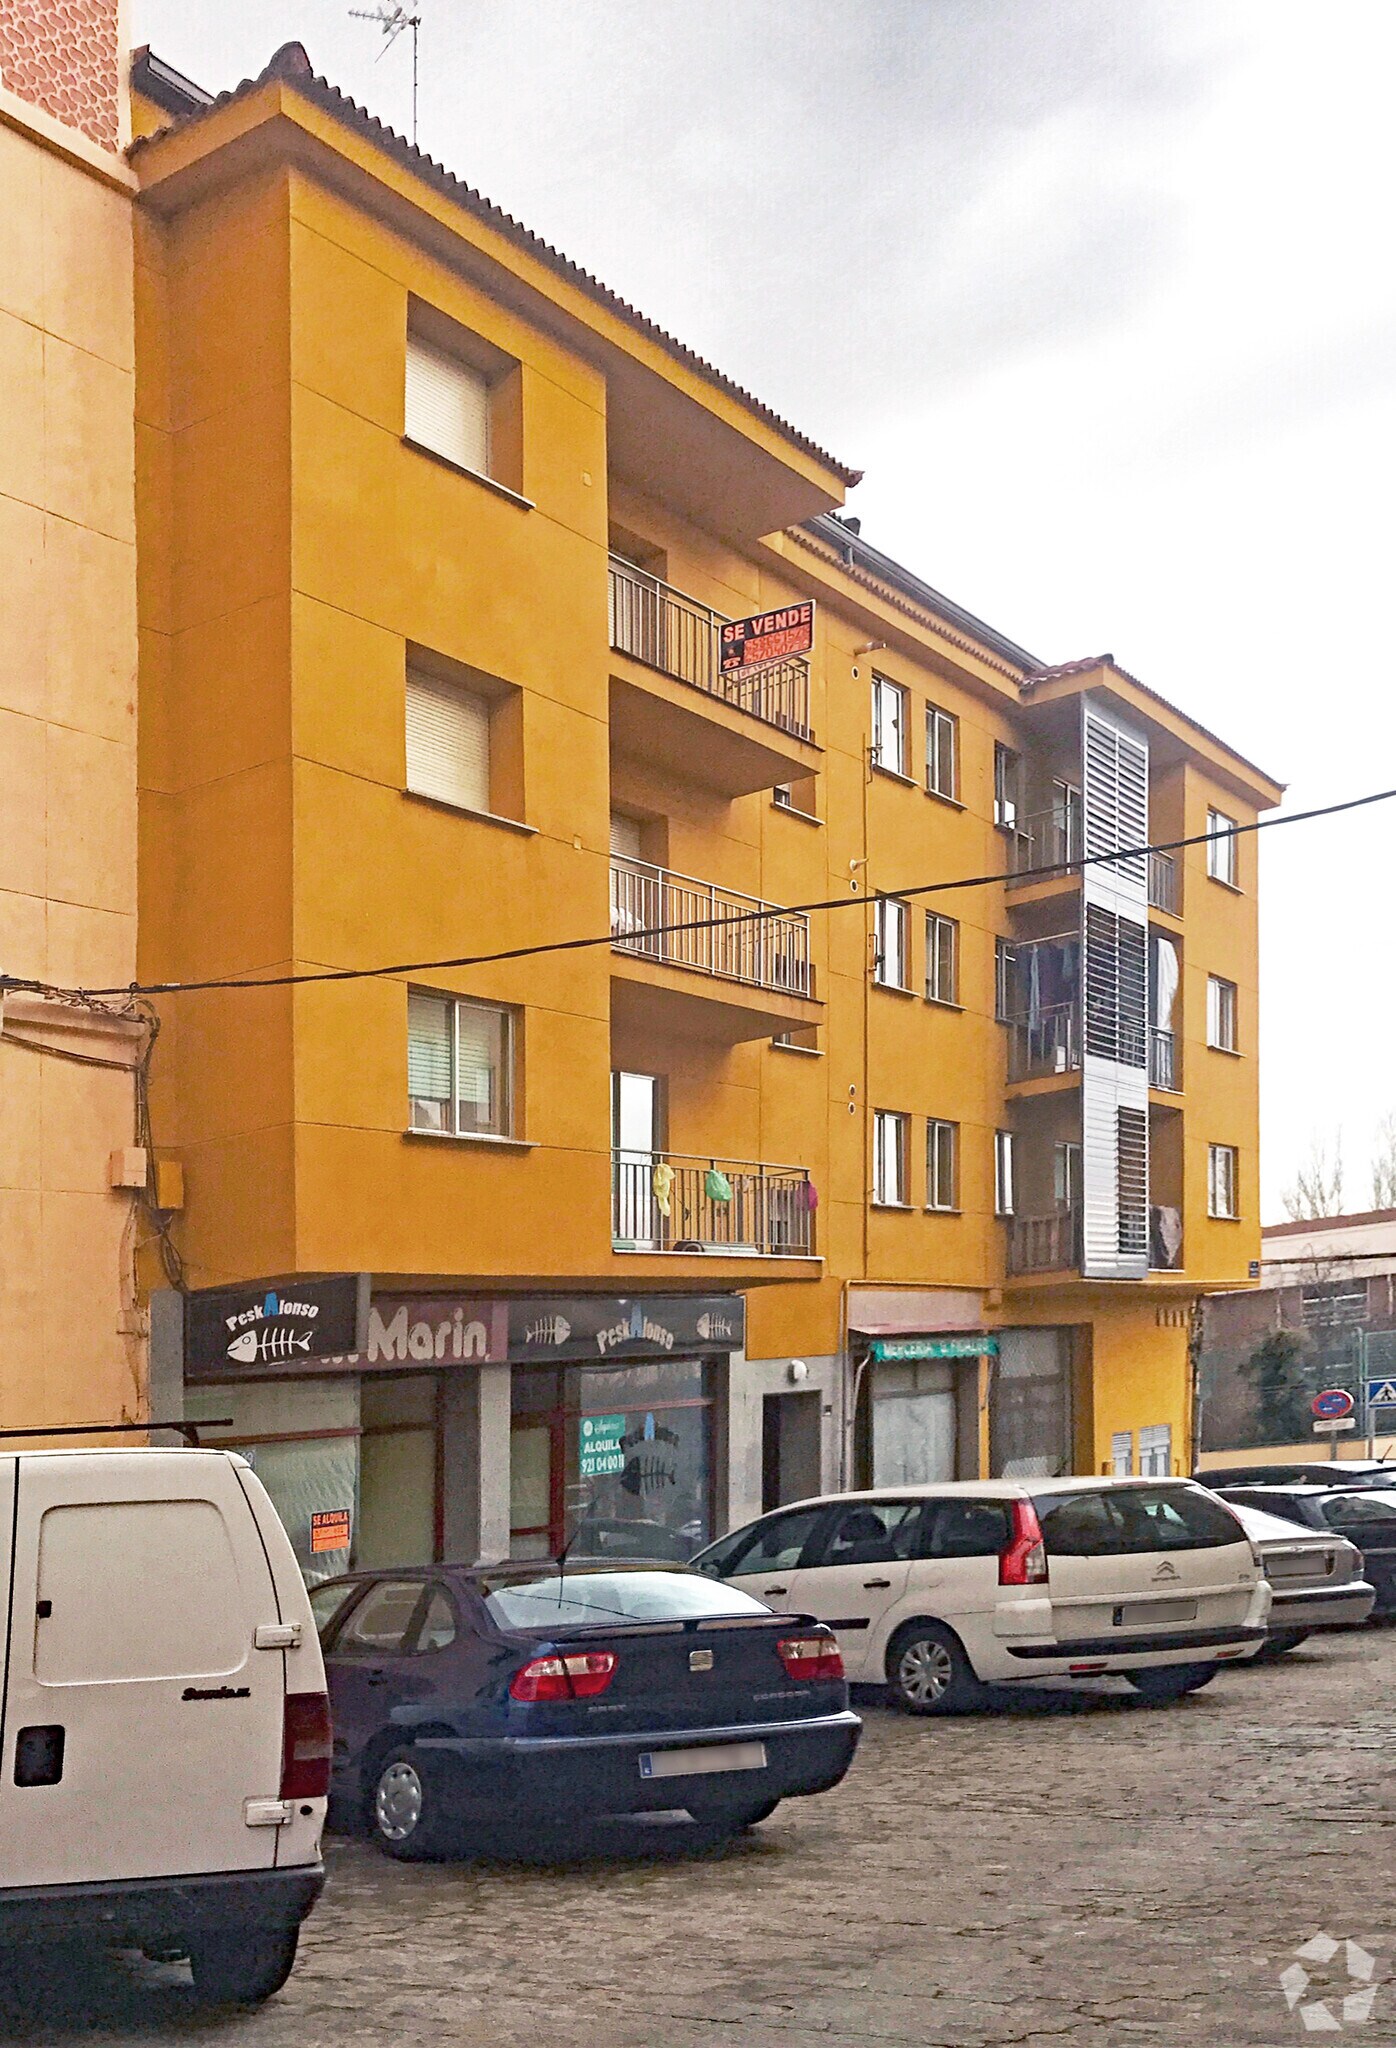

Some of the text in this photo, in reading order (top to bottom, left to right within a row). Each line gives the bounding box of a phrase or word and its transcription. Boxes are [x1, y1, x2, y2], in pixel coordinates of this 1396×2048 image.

[723, 605, 811, 643] SE VENDE
[225, 1291, 319, 1332] PeskAlonso
[367, 1305, 487, 1362] Marin
[583, 1438, 621, 1454] ALQUILA
[581, 1457, 595, 1473] 921
[313, 1514, 321, 1526] SE
